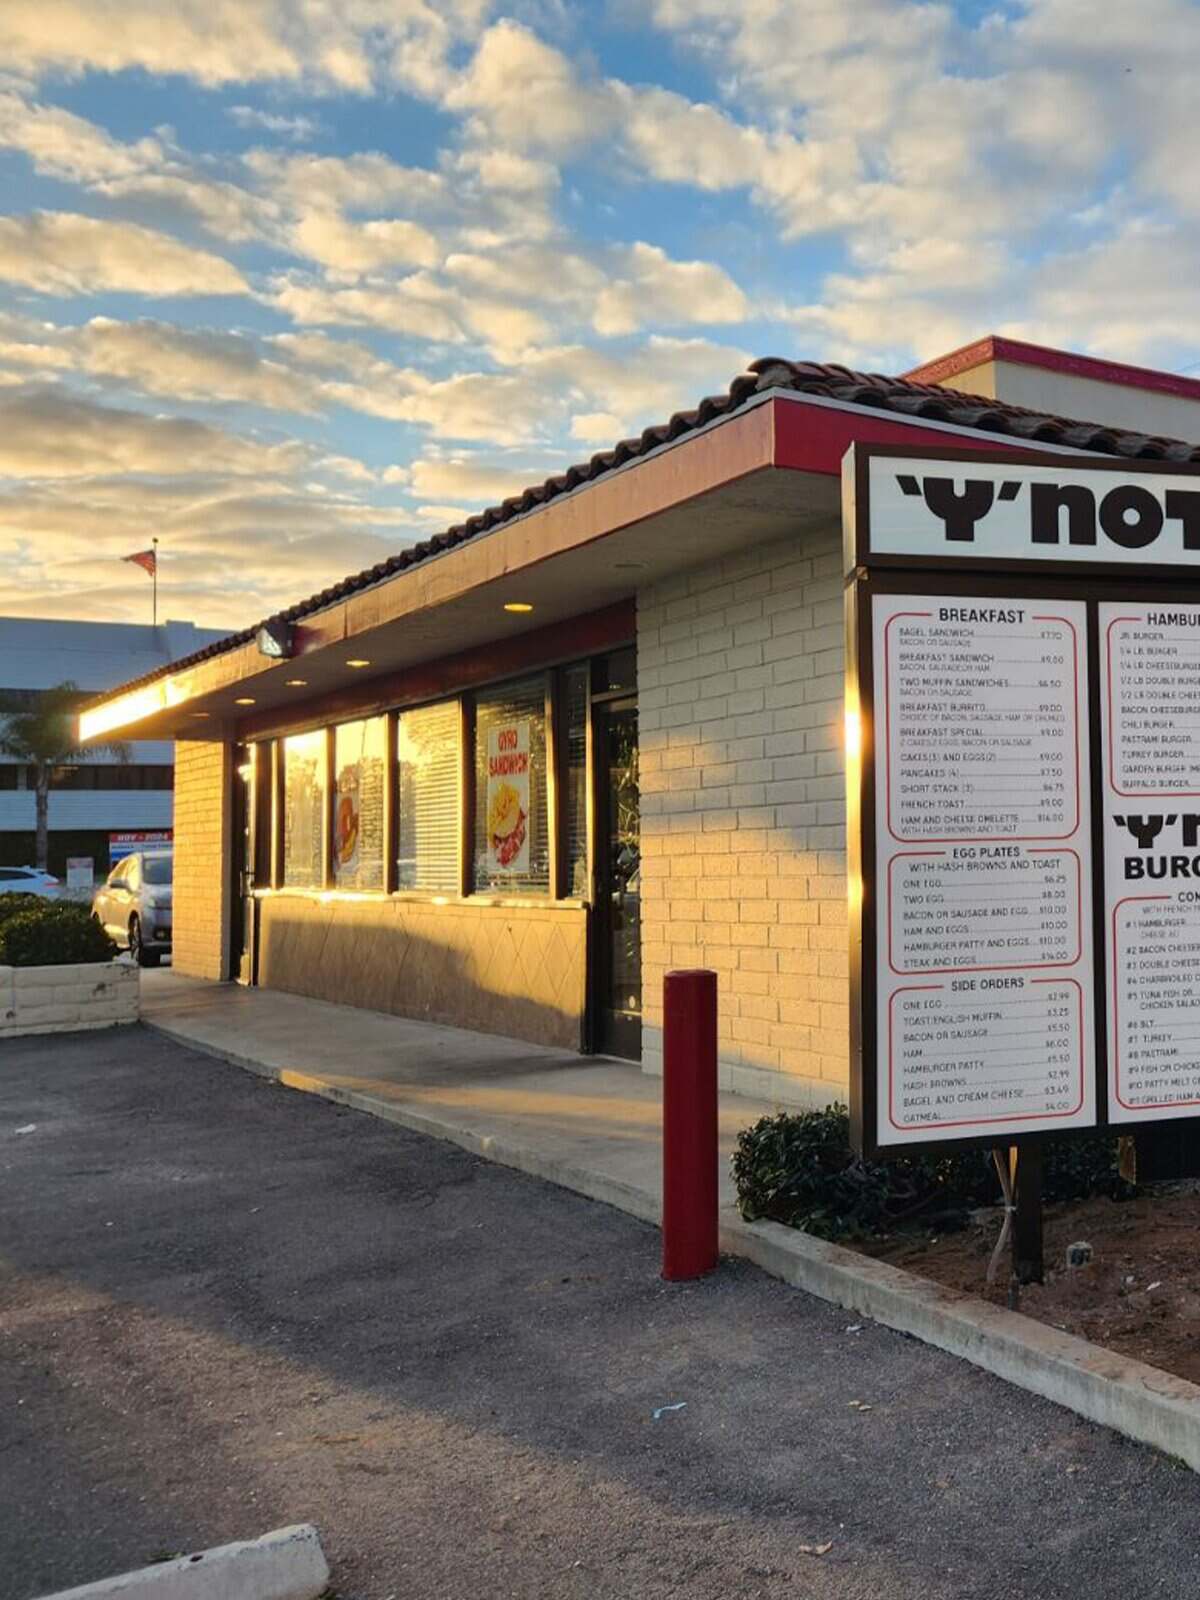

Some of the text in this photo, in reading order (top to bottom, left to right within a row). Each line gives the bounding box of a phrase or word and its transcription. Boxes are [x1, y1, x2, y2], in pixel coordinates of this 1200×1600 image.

[939, 608, 1024, 623] BREAKFAST
[900, 628, 974, 637] BAGEL SANDWICH
[900, 653, 946, 662] BREAKFAST
[950, 654, 994, 662] SANDWICH
[900, 678, 918, 686] TWO
[922, 678, 952, 686] MUFFIN
[955, 679, 1009, 687] SANDWICHES
[901, 703, 946, 712] BREAKFAST
[1121, 706, 1148, 714] BACON
[943, 753, 960, 761] AND
[901, 769, 945, 777] PANCAKES
[901, 785, 929, 793] SHORT
[901, 800, 965, 809] FRENCH TOAST
[901, 816, 920, 824] HAM
[923, 816, 940, 824] AND
[978, 815, 1019, 823] OMELETTE
[953, 847, 1020, 858] EGG PLATES
[909, 859, 1060, 872] WITH HASH BROWNS AND TOAST
[903, 880, 920, 888] ONE
[904, 896, 923, 904] TWO
[904, 911, 933, 920] BACON
[991, 908, 1007, 917] AND
[904, 927, 922, 936] HAM
[925, 926, 943, 935] AND
[988, 939, 1005, 948] AND
[1139, 945, 1166, 954] BACON
[1139, 960, 1170, 969] DOUBLE
[952, 978, 1024, 992] SIDE ORDERS
[903, 1002, 920, 1010] ONE
[904, 1033, 933, 1043] BACON
[904, 1049, 922, 1058] HAM
[959, 1061, 984, 1070] PATTY
